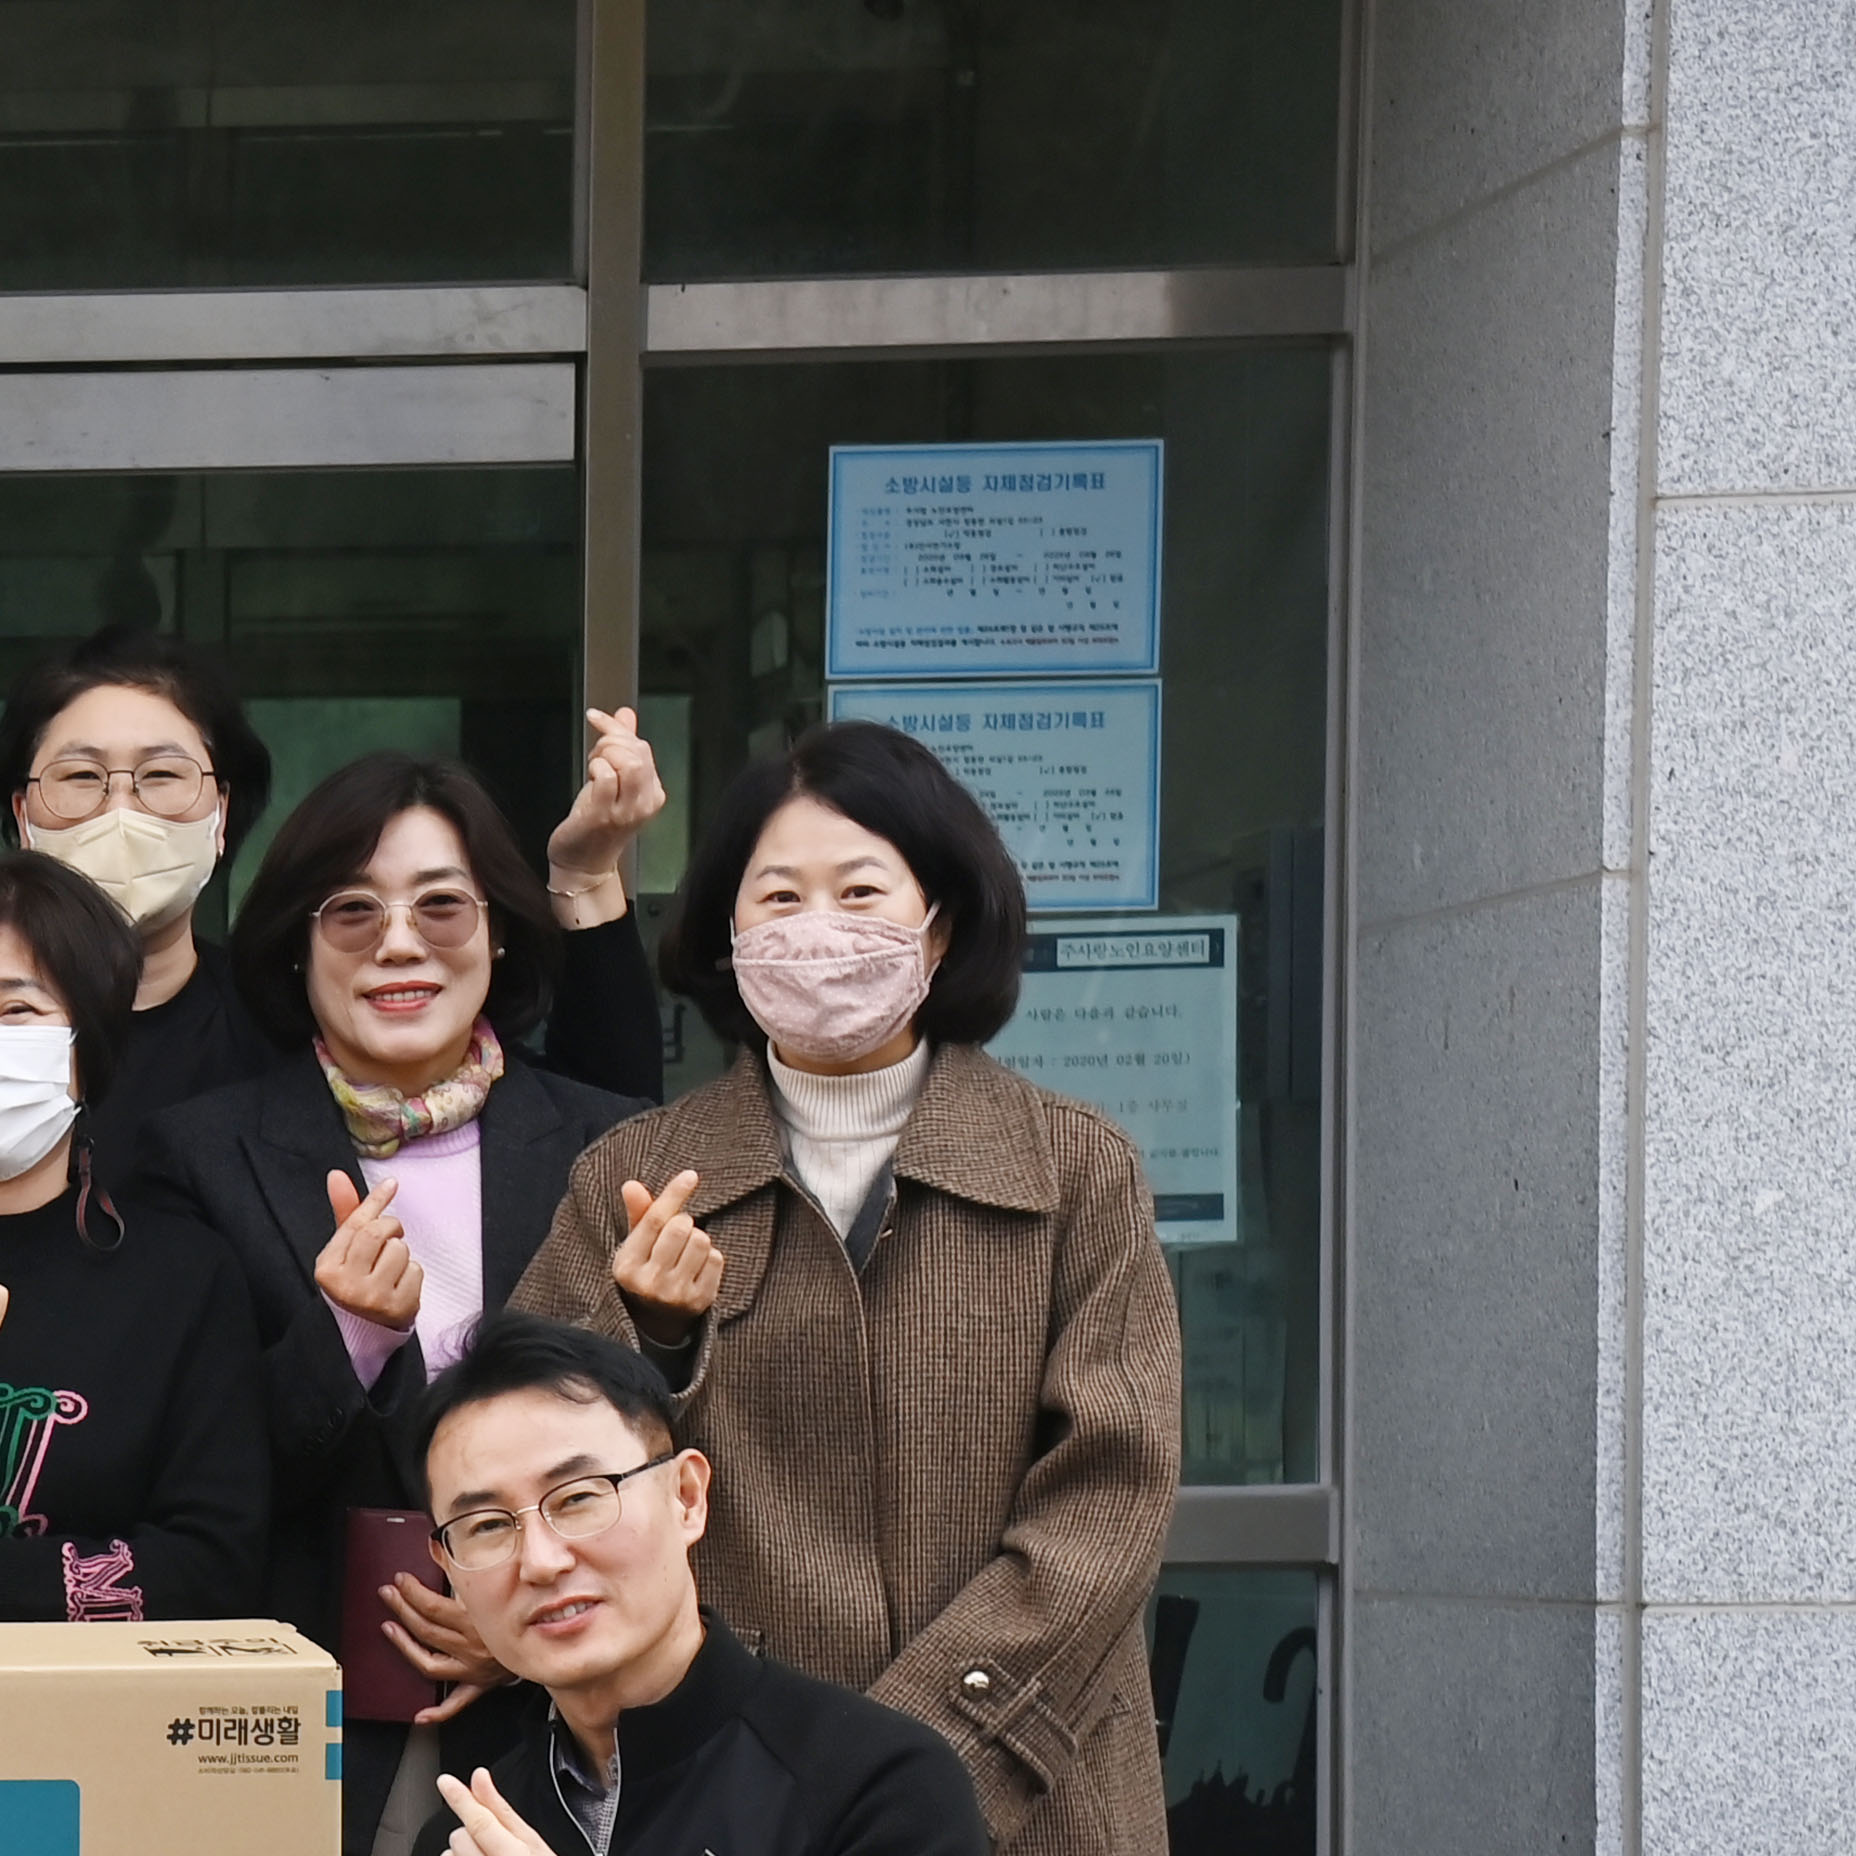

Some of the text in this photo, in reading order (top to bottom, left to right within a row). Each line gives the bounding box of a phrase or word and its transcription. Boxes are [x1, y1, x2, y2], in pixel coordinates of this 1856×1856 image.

[885, 472, 1106, 496] 소방시설등 자체점검기록표
[982, 711, 1106, 732] 자체점검기록표
[166, 1716, 301, 1746] #미래생활
[198, 1754, 298, 1766] www.jjtissue.com
